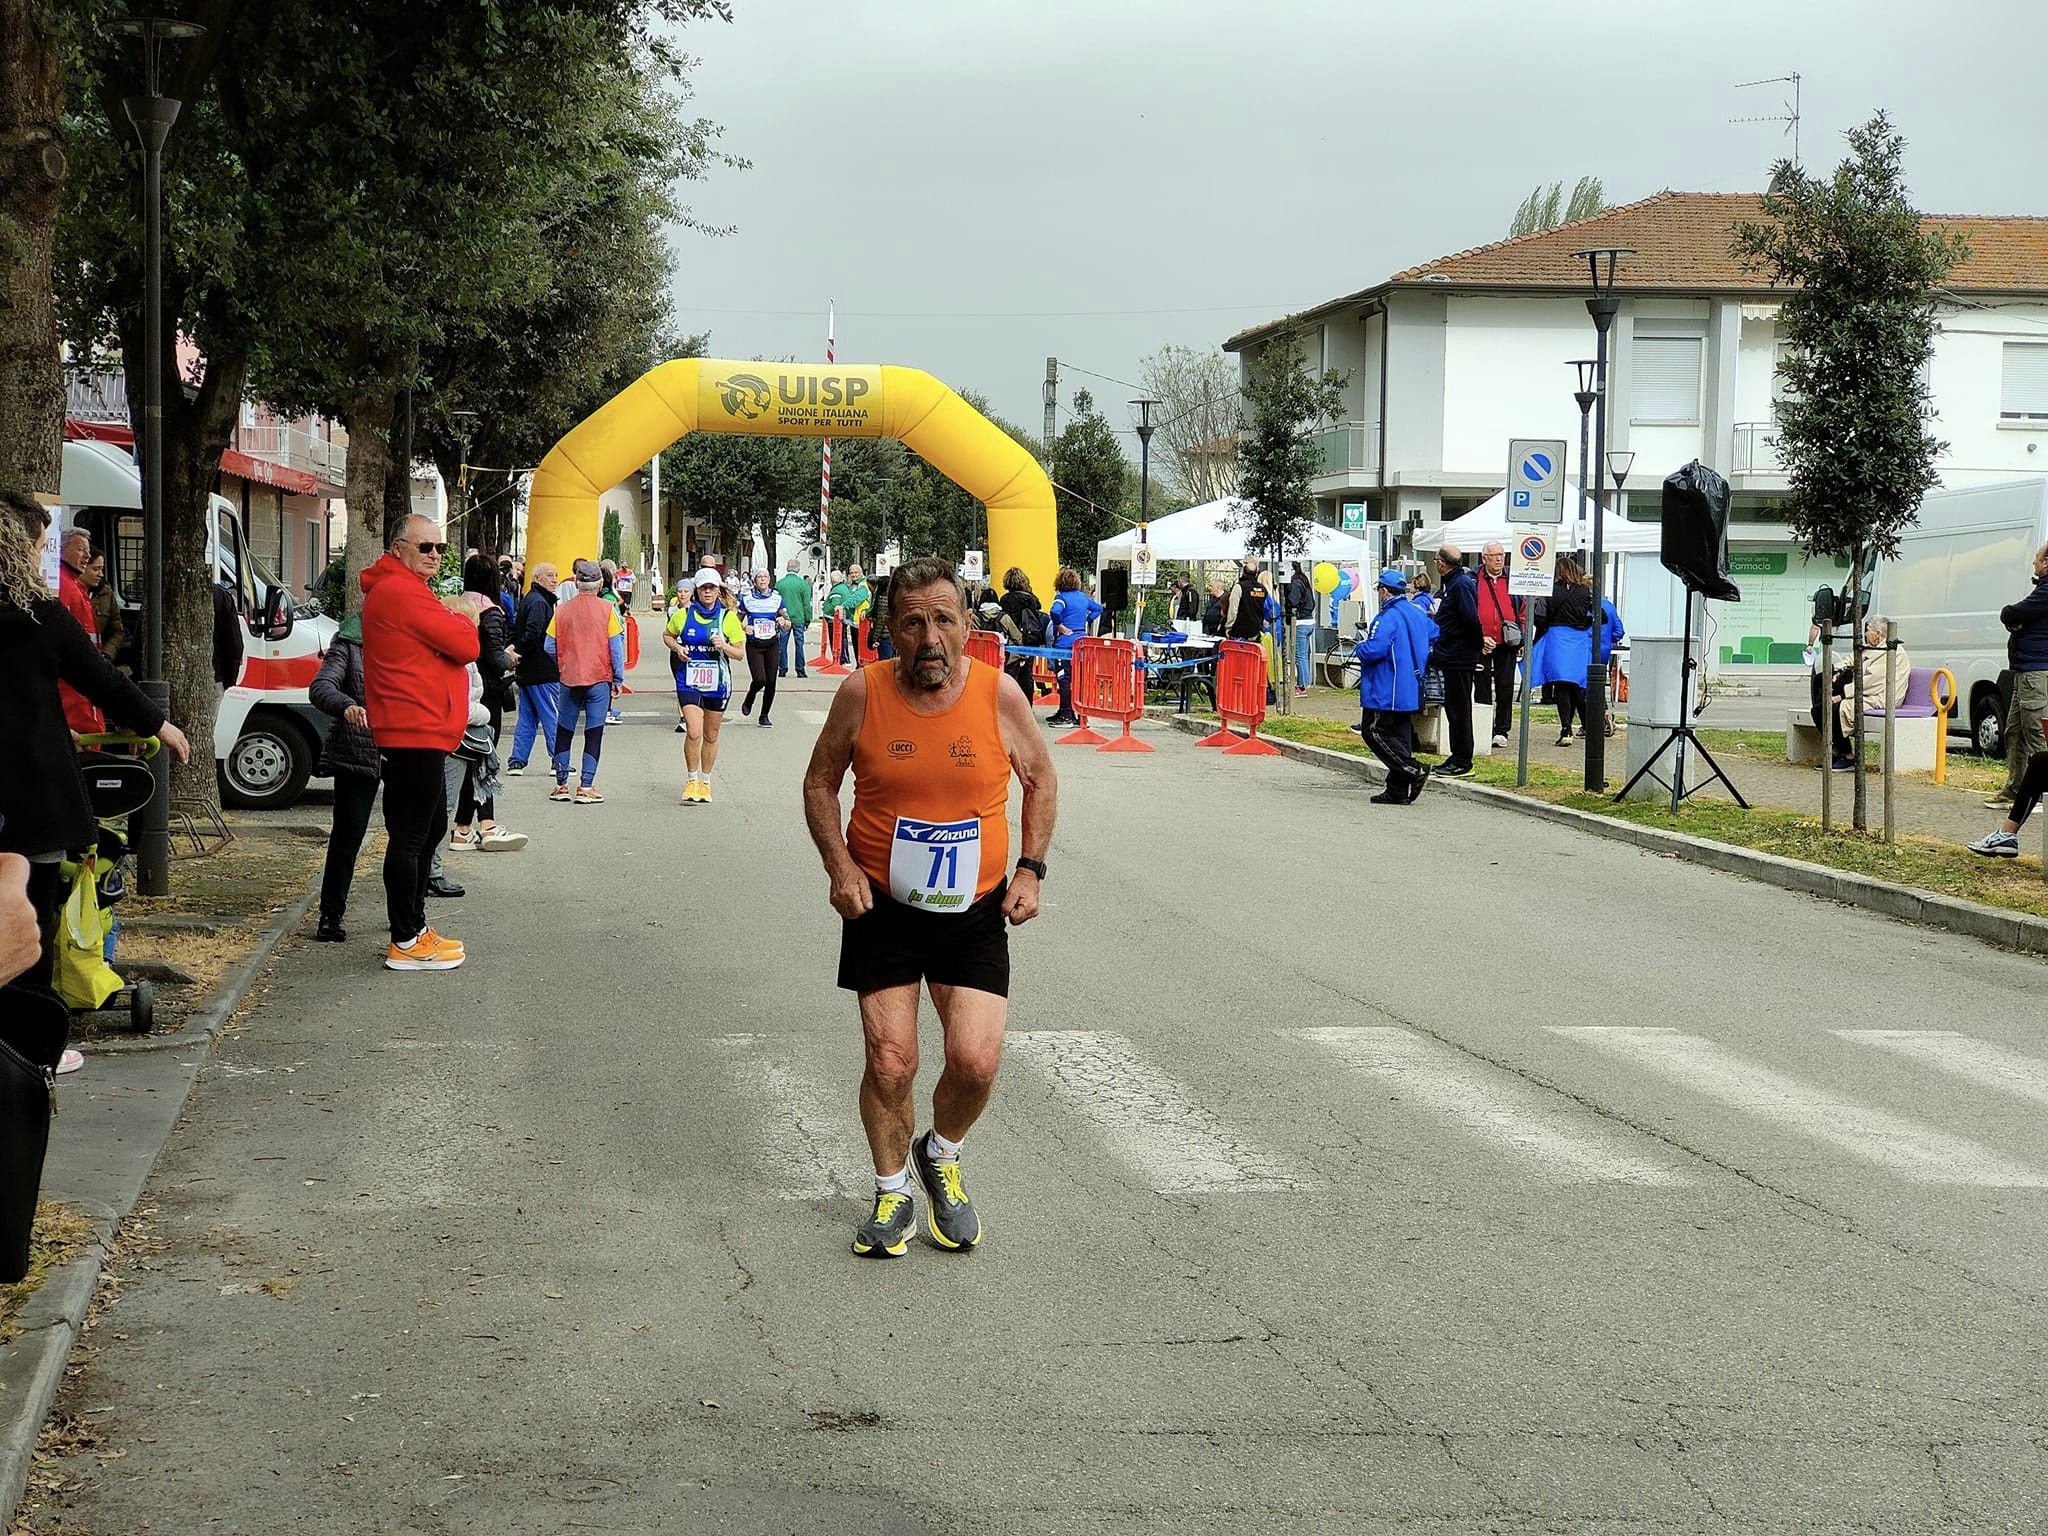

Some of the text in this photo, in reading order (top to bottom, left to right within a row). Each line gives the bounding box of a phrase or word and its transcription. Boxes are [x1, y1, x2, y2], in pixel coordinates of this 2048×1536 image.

[778, 375, 869, 406] UISP
[778, 407, 868, 418] UNIONE ITALIANA
[778, 417, 863, 427] SPORT PER TUTTI
[1515, 492, 1527, 506] P
[1730, 561, 1771, 571] Farmacia
[693, 669, 713, 684] 208
[891, 743, 913, 752] LUCCI
[926, 846, 958, 889] 71
